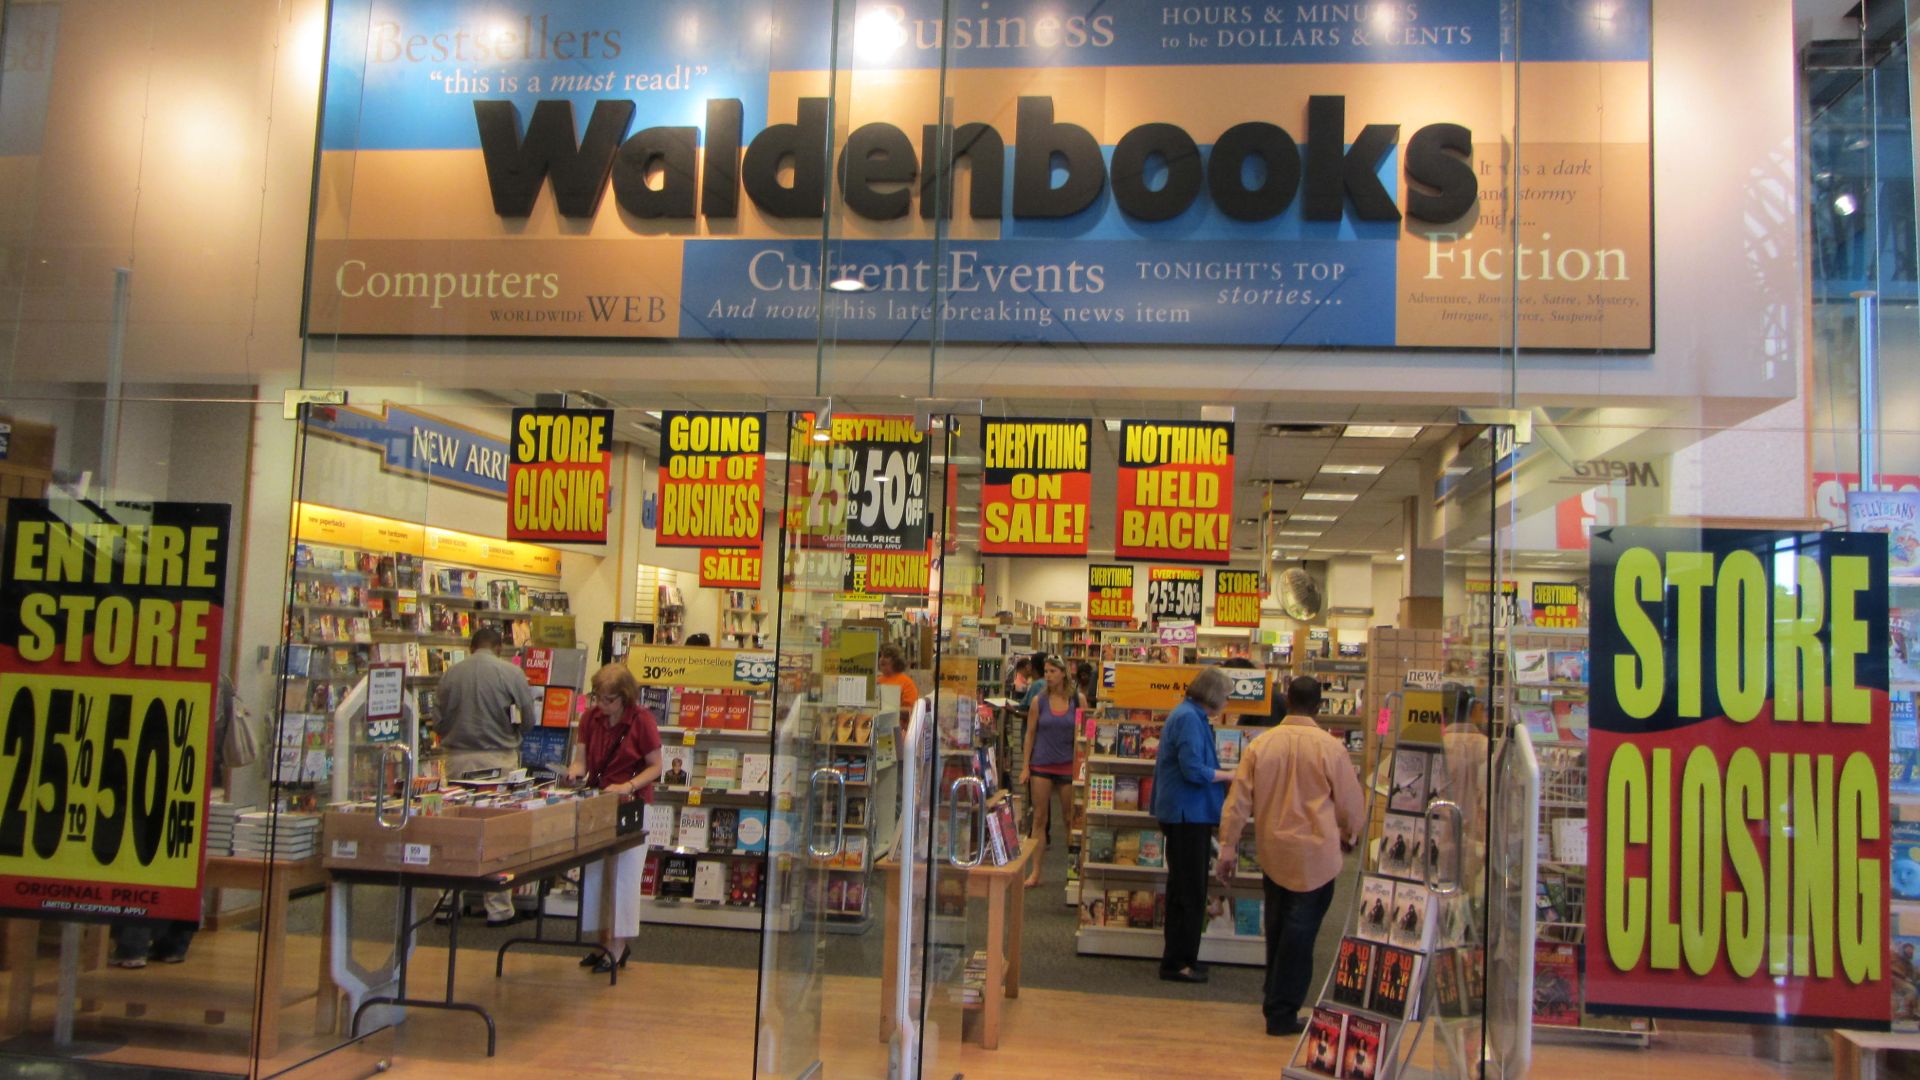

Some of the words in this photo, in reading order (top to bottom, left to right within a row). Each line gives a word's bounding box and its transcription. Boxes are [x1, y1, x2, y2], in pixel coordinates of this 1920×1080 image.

[1162, 6, 1253, 25] HOURS
[1264, 6, 1284, 24] &
[1296, 3, 1417, 24] MINUES
[373, 14, 623, 63] Bestsellers
[1162, 34, 1180, 48] to
[1188, 32, 1208, 48] be
[1218, 27, 1340, 47] DOLLARS
[1351, 27, 1371, 46] &
[1384, 26, 1472, 46] CENTS
[499, 69, 518, 93] is
[527, 78, 541, 93] a
[551, 70, 616, 92] must
[474, 95, 1478, 223] Waldenbooks
[1480, 160, 1491, 176] It
[1537, 165, 1545, 176] a
[1553, 159, 1592, 176] dark
[1518, 186, 1576, 205] stormy
[1479, 210, 1536, 230] nig...
[1423, 232, 1631, 282] Fiction
[748, 249, 931, 293] Current
[949, 250, 1105, 294] Events
[1292, 262, 1345, 281] TOP
[336, 259, 559, 309] Computers
[1217, 284, 1342, 305] stories...
[490, 309, 584, 323] WORLDWIDE
[586, 295, 667, 323] WEB
[1408, 291, 1472, 306] Adventure,
[1478, 292, 1536, 306] Romace,
[707, 297, 756, 319] And
[887, 299, 932, 320] late
[944, 300, 1053, 326] breaking
[1063, 304, 1125, 323] news
[1136, 302, 1190, 323] item
[1501, 311, 1544, 323] Hrror,
[1551, 310, 1604, 324] Suspense
[517, 413, 606, 464] STORE
[669, 416, 760, 453] GOING
[812, 418, 924, 444] ERYTHING
[412, 425, 460, 469] NEW
[985, 423, 1087, 470] EVERYTHING
[1125, 425, 1228, 466] NOTHING
[669, 455, 721, 481] OUT
[726, 456, 757, 481] OF
[860, 449, 922, 531] 50%
[905, 498, 923, 527] OFF
[1011, 474, 1062, 500] ON
[1135, 470, 1220, 509] HELD
[513, 467, 605, 534] CLOSING
[662, 483, 760, 538] BUSINESS
[985, 503, 1085, 544] SALE!
[1122, 509, 1230, 551] BACK!
[822, 534, 869, 543] ORIGINAL
[873, 535, 901, 544] PRICE
[13, 520, 219, 588] ENTIRE
[703, 556, 760, 581] SALE!
[870, 553, 929, 588] CLOSING
[1091, 567, 1132, 587] EVERYTHING
[1152, 569, 1200, 580] EVERYTHING
[1101, 587, 1121, 598] ON
[1218, 571, 1259, 594] STORE
[1534, 585, 1577, 604] EVERYTHING
[1090, 599, 1132, 617] SALE!
[1217, 596, 1259, 623] CLOSING
[1545, 605, 1567, 616] ON
[18, 593, 211, 668] STORE
[1535, 617, 1577, 628] SALE!
[1613, 547, 1872, 725] STORE
[526, 659, 549, 668] CLANCY
[532, 650, 545, 660] TOM
[644, 653, 686, 665] hardcover
[688, 656, 733, 667] bestsellers
[642, 666, 673, 679] 30%
[674, 667, 686, 676] off
[736, 661, 776, 678] 30%
[1408, 671, 1435, 682] new
[1150, 682, 1170, 691] new
[67, 801, 88, 842] TO
[91, 693, 196, 867] 50%
[167, 800, 196, 860] OFF
[681, 819, 705, 829] BRAND
[1605, 742, 1882, 985] CLOSING
[15, 881, 103, 901] ORIGINAL
[111, 887, 161, 905] PRICE
[42, 899, 72, 910] LIMITED
[74, 902, 121, 914] EXCEPTIONS
[124, 905, 147, 916] APPLY
